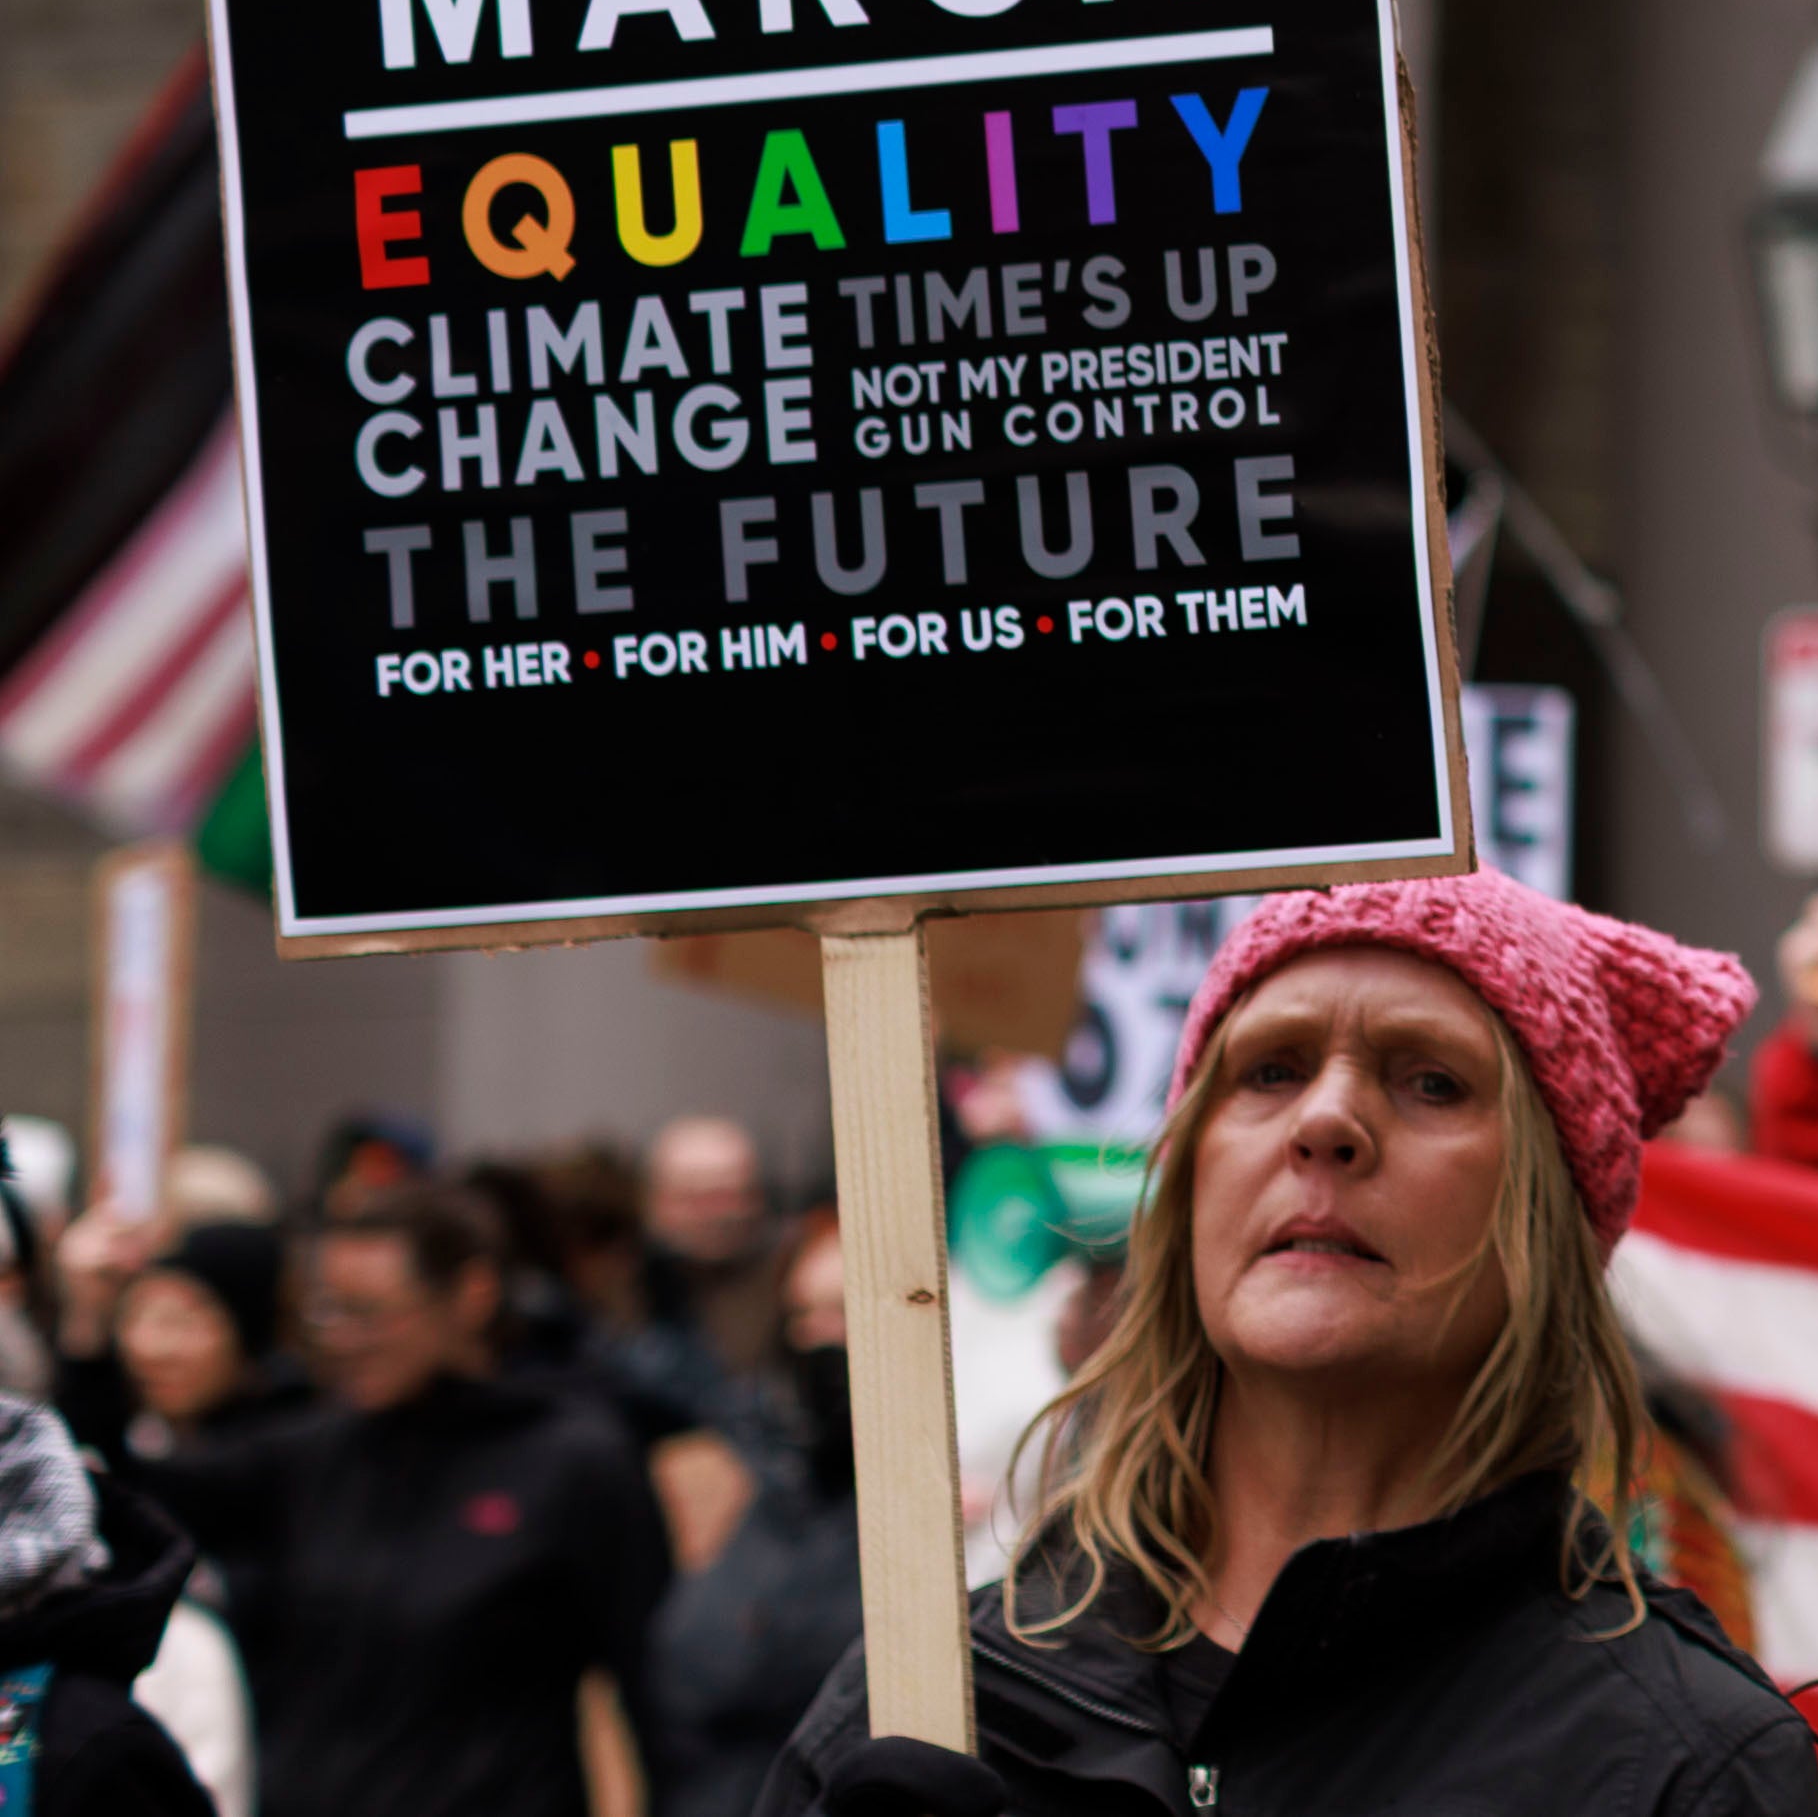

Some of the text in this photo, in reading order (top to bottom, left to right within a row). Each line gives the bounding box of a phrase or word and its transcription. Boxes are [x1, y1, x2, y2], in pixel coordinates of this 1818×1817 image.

[355, 87, 1268, 289] EQUALITY
[347, 284, 812, 403] CLIMATE
[839, 244, 1276, 348] TIME'S UP
[852, 334, 1287, 409] NOT MY PRESIDENT
[855, 386, 1280, 457] GUN CONTROL
[356, 378, 816, 496] CHANGE
[364, 455, 1300, 628] THE FUTURE
[377, 584, 1306, 696] FOR HER FOR HIM FOR US FOR THEM
